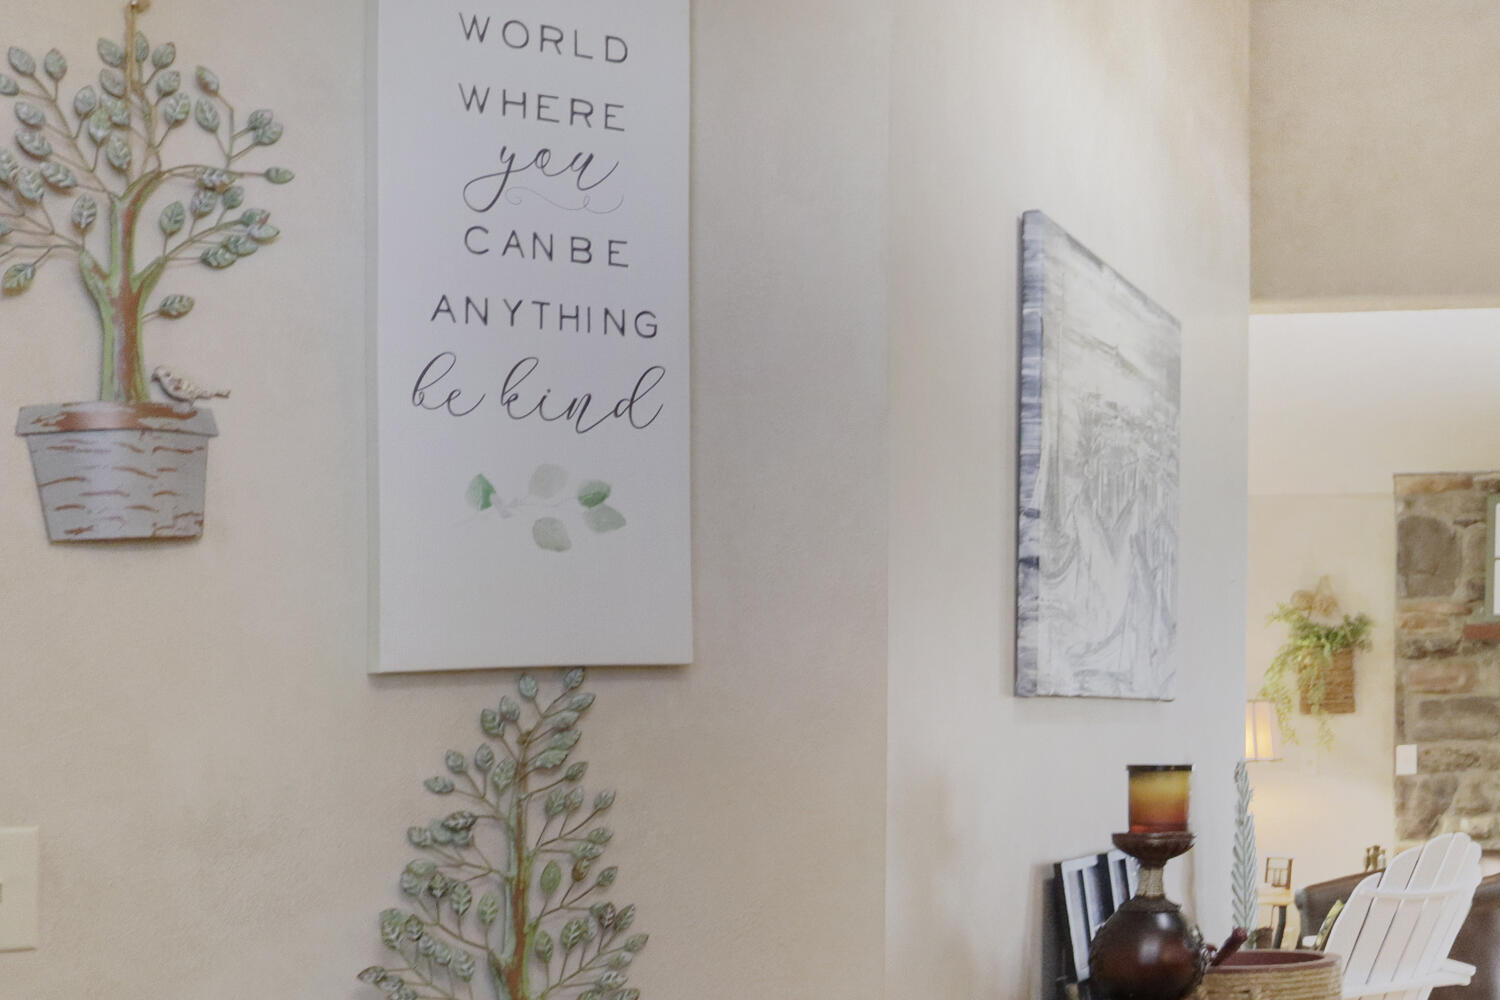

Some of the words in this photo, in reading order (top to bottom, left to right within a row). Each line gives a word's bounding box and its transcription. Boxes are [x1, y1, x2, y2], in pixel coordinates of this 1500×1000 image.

[457, 11, 628, 64] WORLD
[457, 82, 625, 132] WHERE
[463, 145, 619, 213] you
[430, 294, 658, 339] ANYTHING
[412, 351, 486, 417] be
[500, 356, 666, 434] kind
